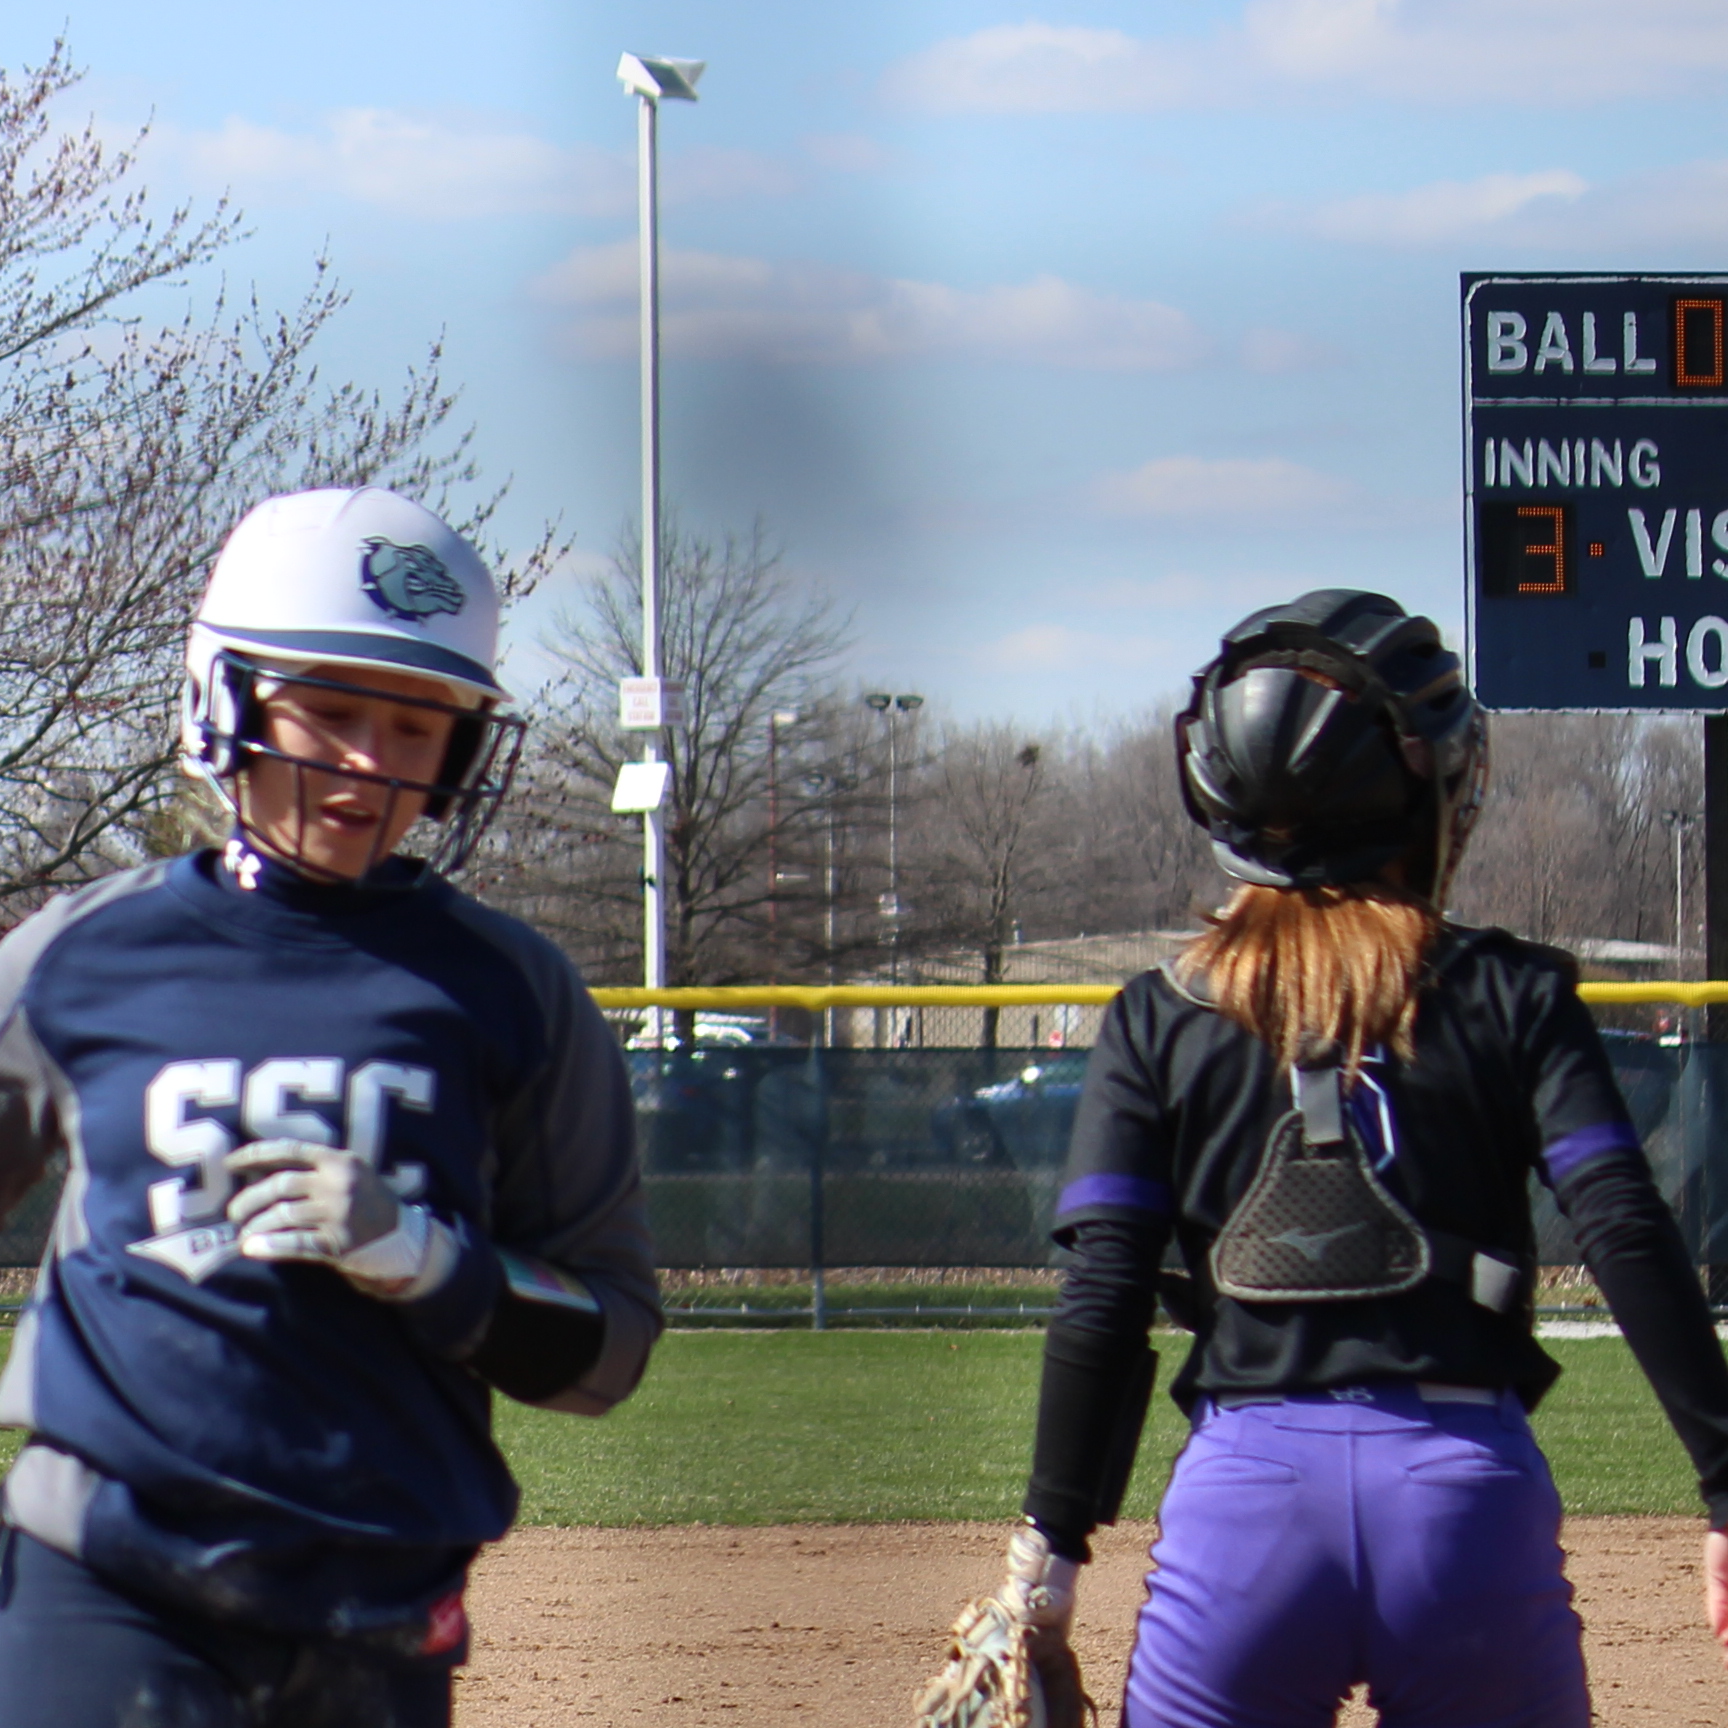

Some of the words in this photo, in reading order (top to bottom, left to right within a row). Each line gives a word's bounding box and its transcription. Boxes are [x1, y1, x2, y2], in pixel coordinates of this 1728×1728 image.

[1487, 310, 1657, 375] BALL
[1483, 437, 1661, 488] INNING
[1517, 507, 1565, 594] 3
